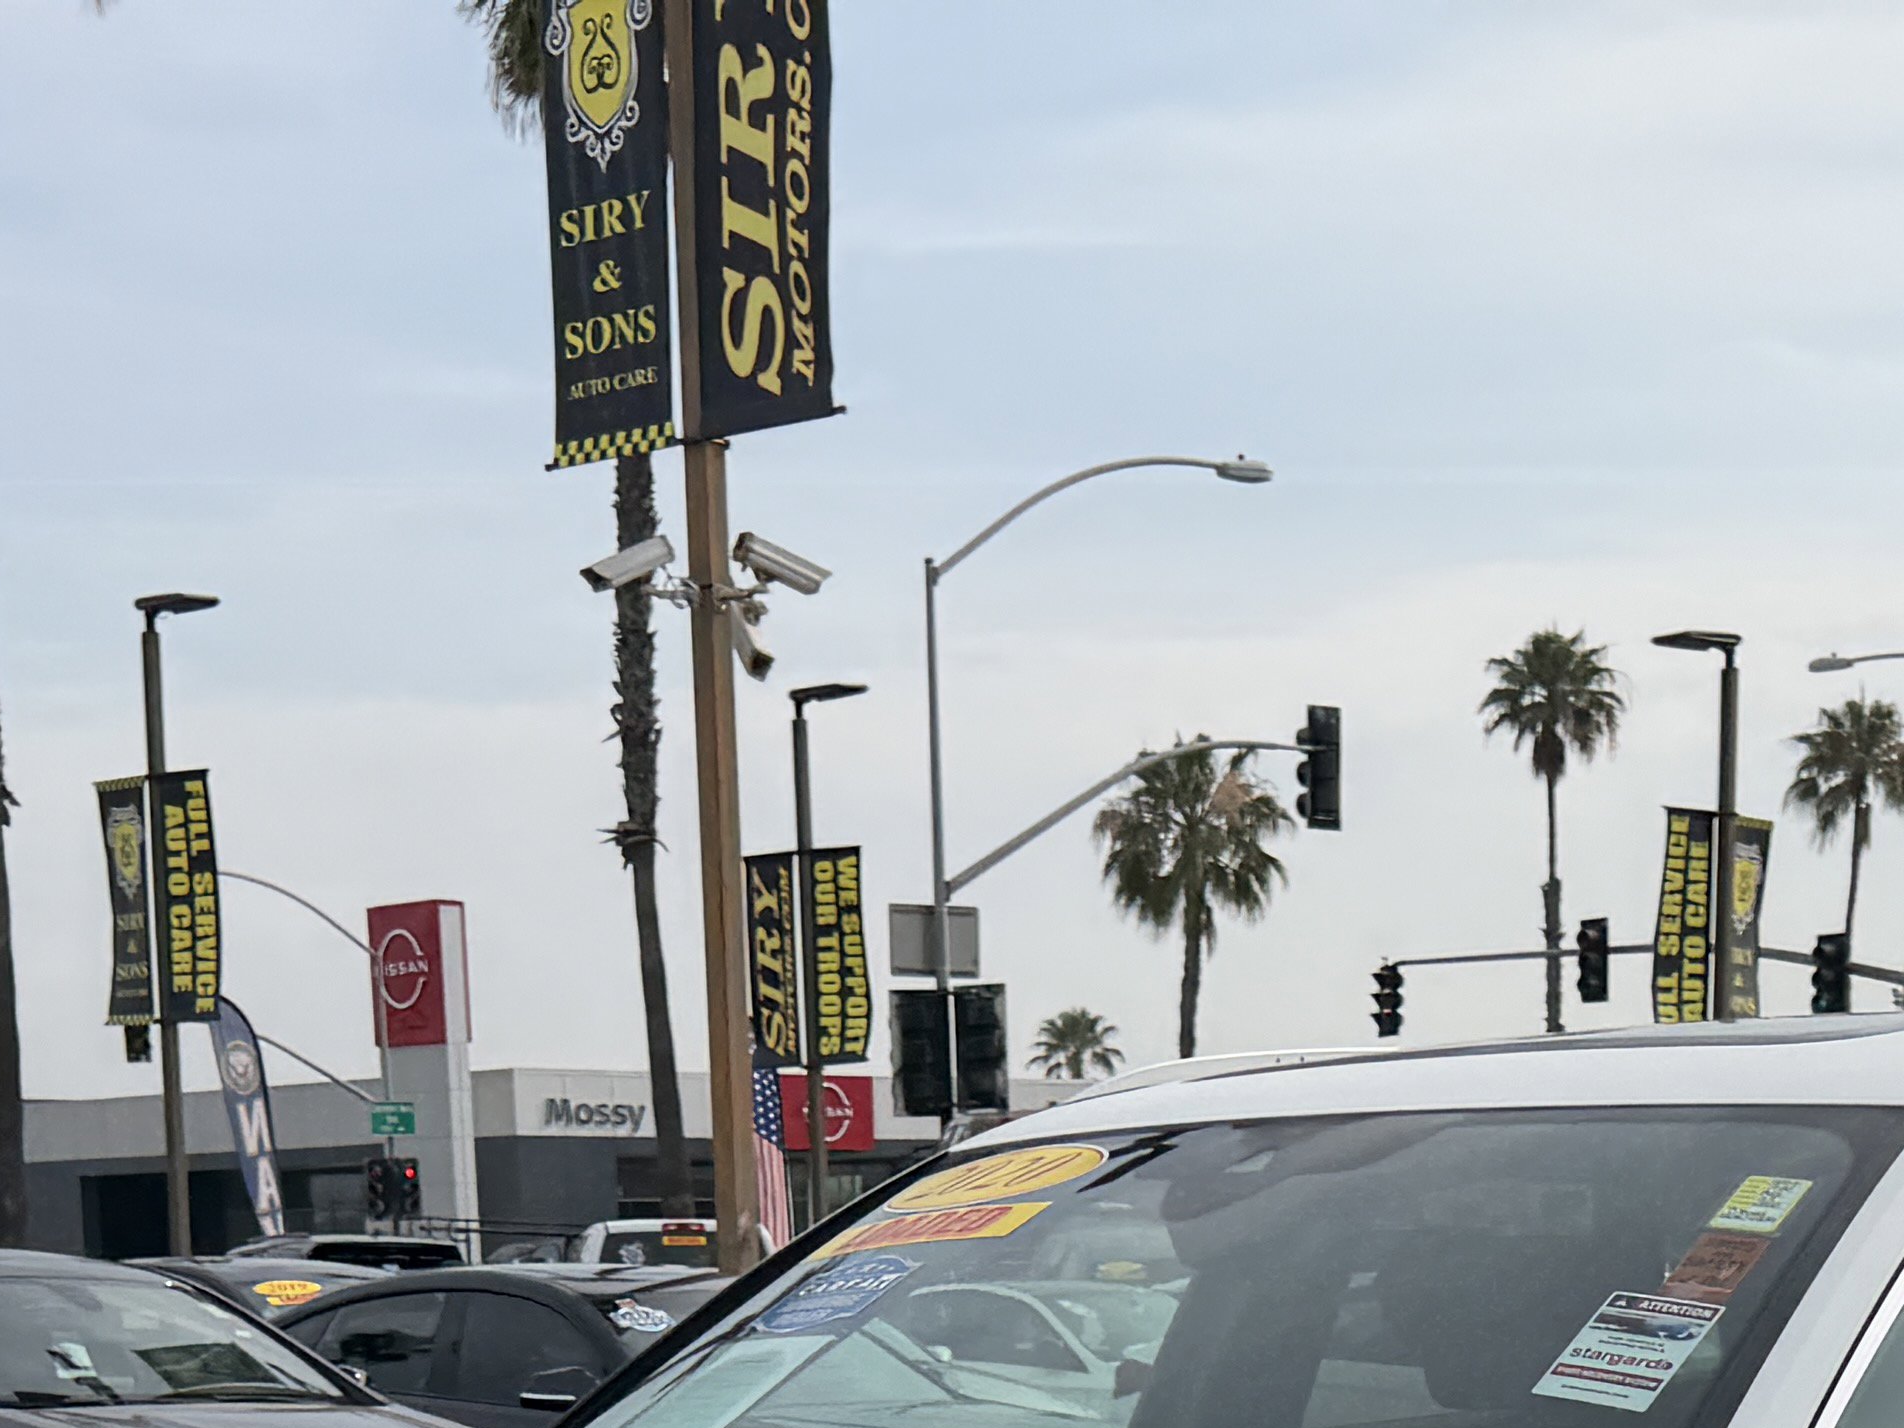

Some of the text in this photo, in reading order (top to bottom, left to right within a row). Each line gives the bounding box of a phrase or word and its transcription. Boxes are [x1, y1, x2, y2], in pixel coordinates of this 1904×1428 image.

[558, 190, 651, 249] SIRY
[593, 260, 623, 293] &
[717, 0, 785, 397] SIR
[564, 305, 657, 360] SONS
[567, 366, 658, 400] AUTO CARE
[164, 804, 193, 993] AUTO CARE
[184, 780, 217, 1014] FULL SERVICE
[375, 960, 429, 977] ISSAN
[751, 866, 785, 1057] SIRY
[814, 860, 841, 1057] OUR TROOPS
[836, 855, 868, 1056] WE SUPPORT
[1656, 815, 1690, 1024] ULL SERVICE
[1682, 841, 1709, 1022] AUTO CARE
[543, 1098, 646, 1133] Mossy
[1639, 1298, 1715, 1319] ATTENTION
